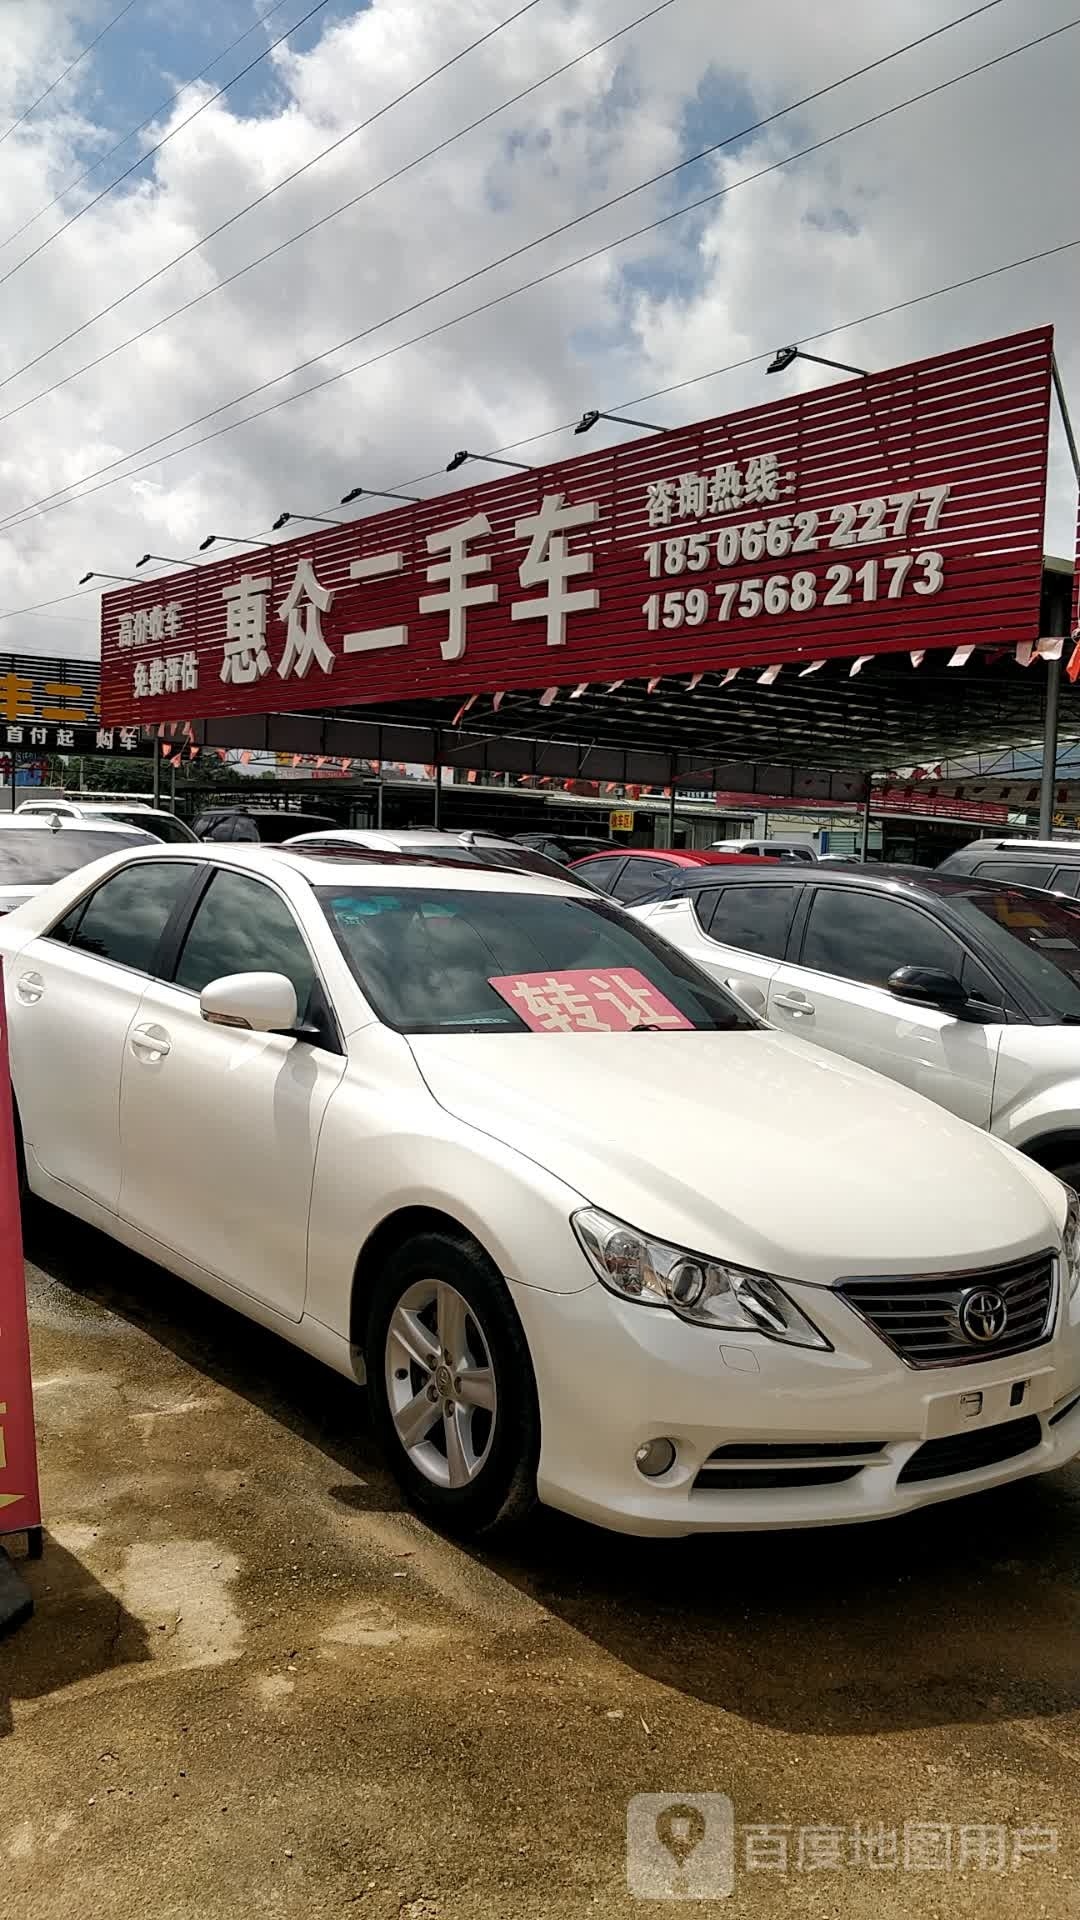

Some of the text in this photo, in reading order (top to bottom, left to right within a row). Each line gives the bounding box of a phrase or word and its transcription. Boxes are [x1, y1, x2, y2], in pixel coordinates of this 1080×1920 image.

[646, 454, 798, 527] 咨询热线:
[219, 494, 600, 684] 惠众二手车
[117, 600, 182, 648] 高价收车
[133, 650, 199, 698] 免费评估
[5, 725, 75, 747] 首付起
[511, 974, 682, 1033] 转让
